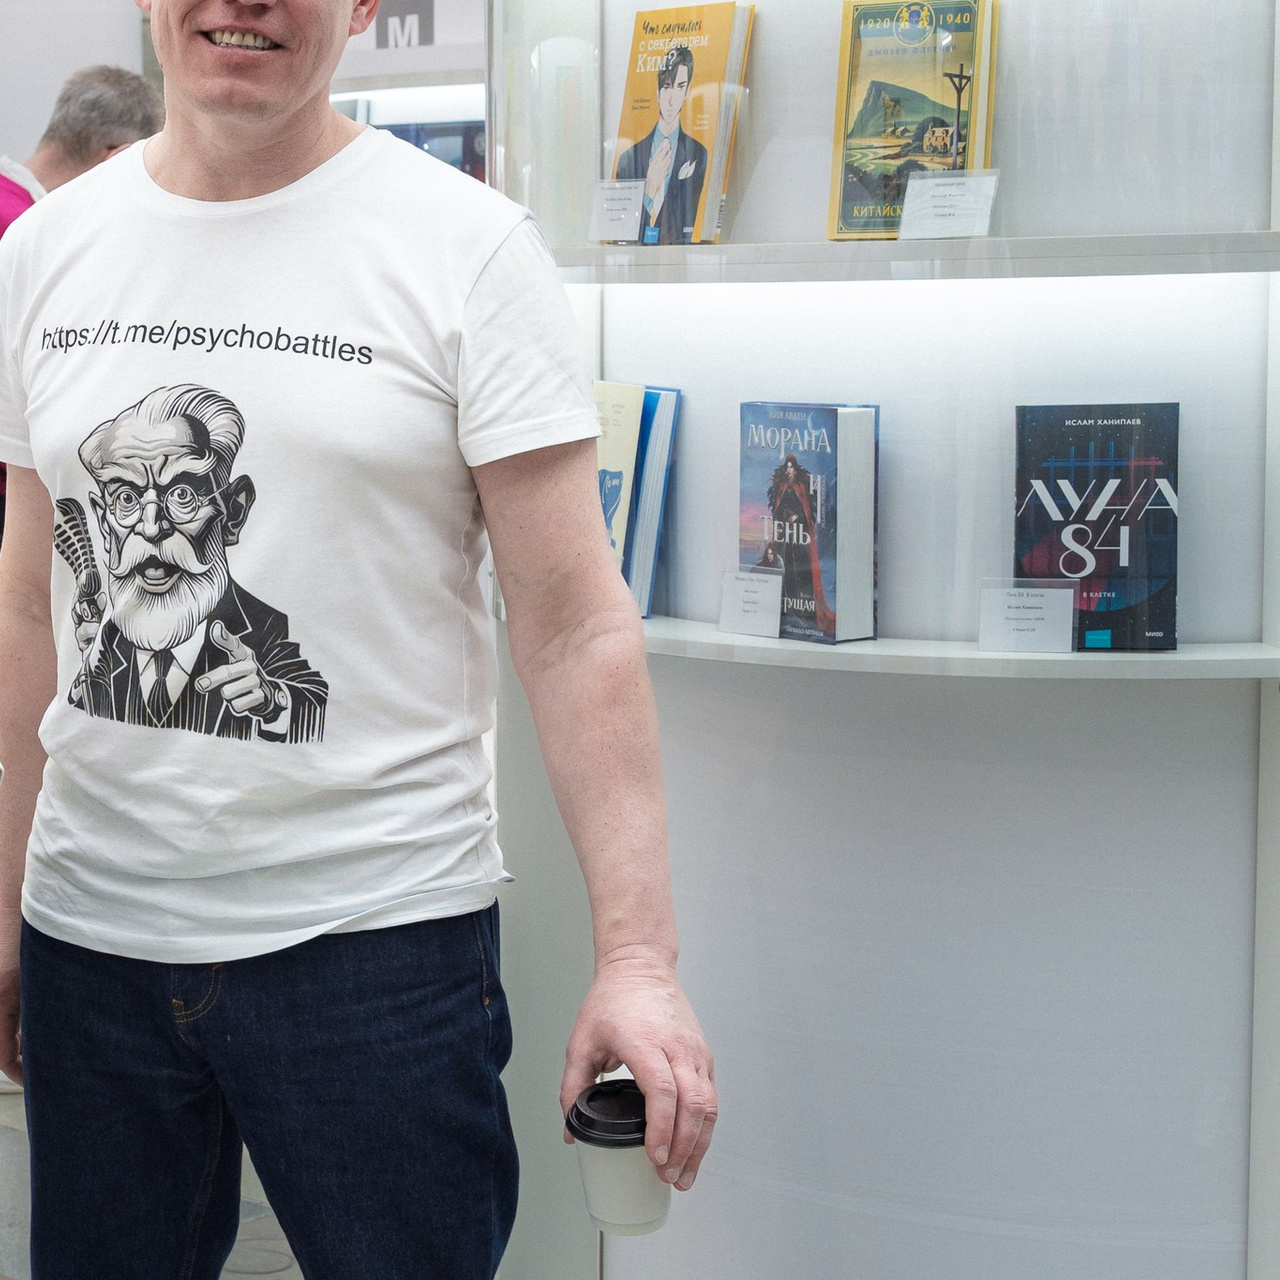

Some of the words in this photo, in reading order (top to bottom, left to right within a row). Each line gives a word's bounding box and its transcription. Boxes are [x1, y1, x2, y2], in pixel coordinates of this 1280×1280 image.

[642, 19, 660, 35] Что
[860, 16, 891, 30] 1920
[939, 12, 971, 25] 1940
[635, 50, 677, 73] Ким?
[852, 203, 903, 218] КИТАЙСК
[40, 319, 374, 365] https://t.me/psychobattles
[1096, 418, 1142, 426] ХАНИПАЕВ
[747, 423, 832, 461] МОРАНА
[1017, 478, 1179, 521] ЛУНА
[759, 515, 811, 546] ТЕНЬ
[1059, 514, 1130, 578] 84
[783, 597, 816, 613] ТУЩАЯ
